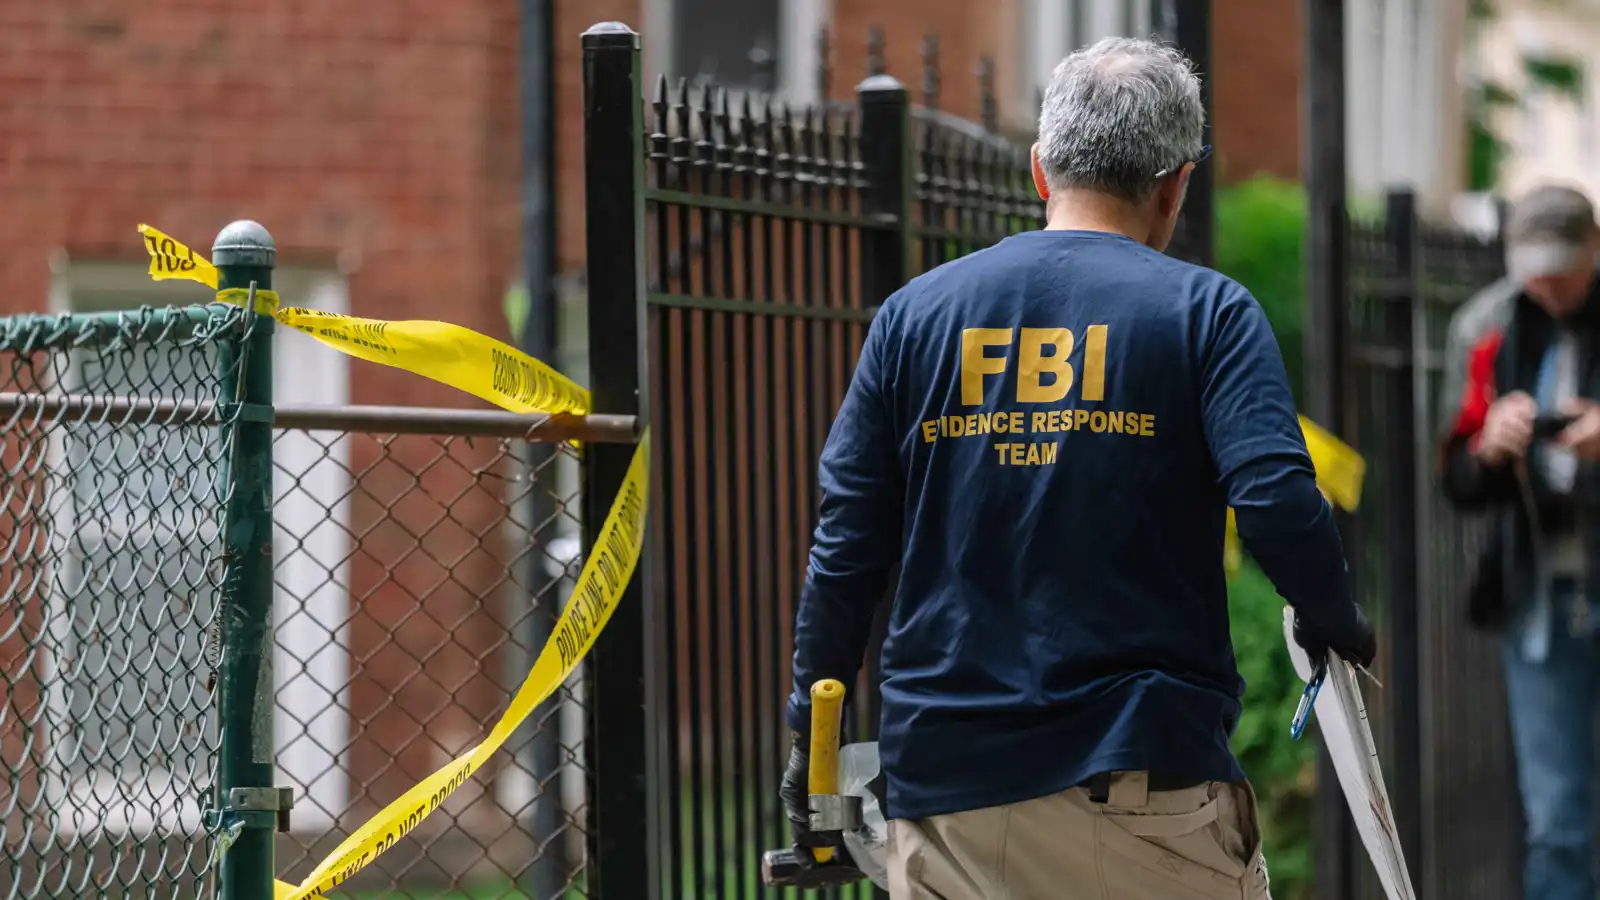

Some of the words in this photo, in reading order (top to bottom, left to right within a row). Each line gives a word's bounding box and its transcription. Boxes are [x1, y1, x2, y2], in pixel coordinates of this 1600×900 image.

[961, 324, 1108, 406] FBI
[922, 411, 1025, 443] EIDENCE
[1032, 410, 1156, 436] RESPONSE
[994, 442, 1058, 466] TEAM
[556, 601, 590, 674] POLICE
[581, 571, 609, 627] LINE
[596, 551, 619, 598] DO
